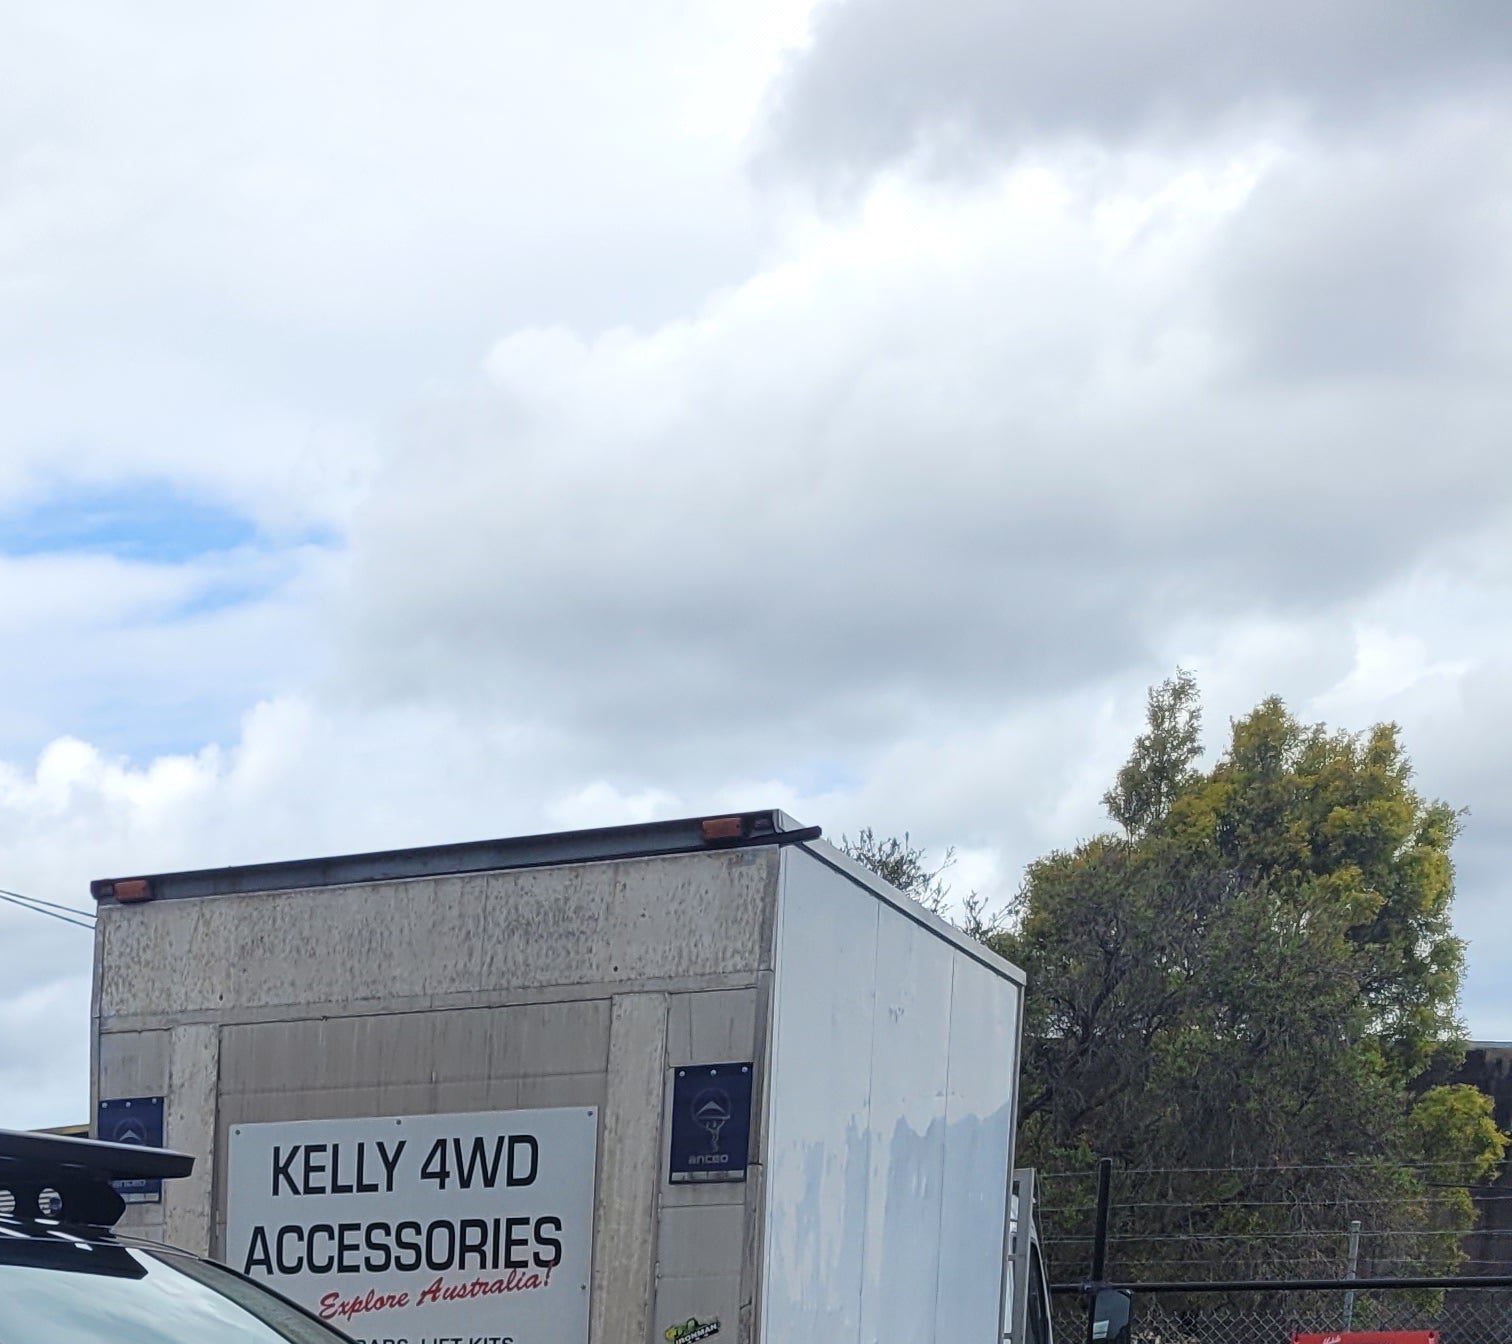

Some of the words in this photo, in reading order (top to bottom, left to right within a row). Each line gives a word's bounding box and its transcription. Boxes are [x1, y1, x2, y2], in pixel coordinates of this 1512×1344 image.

[272, 1140, 407, 1196] KELLY
[420, 1134, 539, 1190] 4WD
[244, 1216, 563, 1275] ACCESSORIES
[319, 1289, 410, 1321] Explore
[416, 1261, 554, 1306] Australia!
